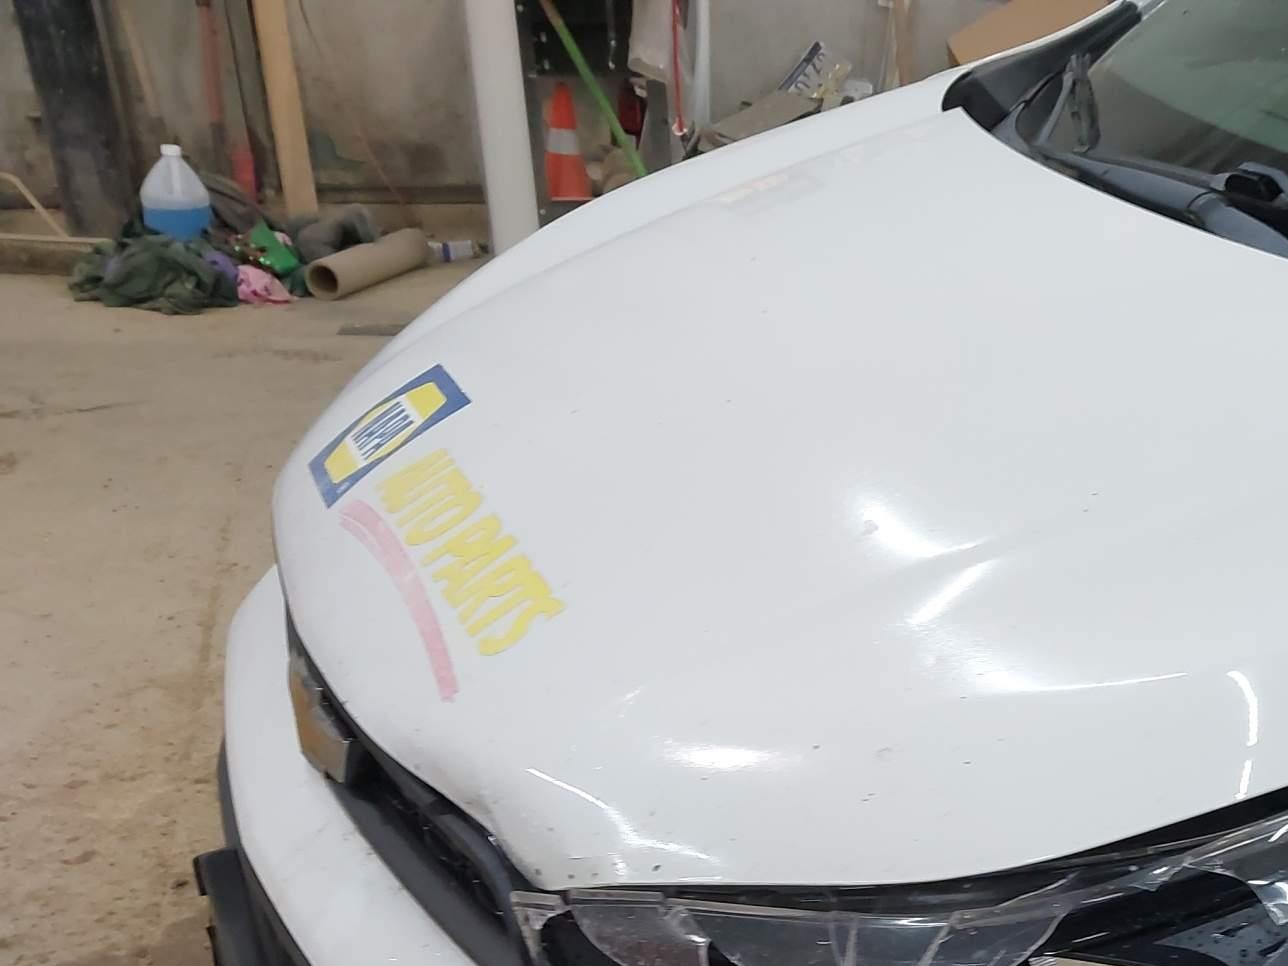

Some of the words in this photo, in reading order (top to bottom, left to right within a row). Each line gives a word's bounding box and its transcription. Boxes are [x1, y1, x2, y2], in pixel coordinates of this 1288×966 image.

[352, 402, 414, 460] NAPA
[378, 448, 483, 546] AUTO
[422, 514, 565, 656] PARTS
